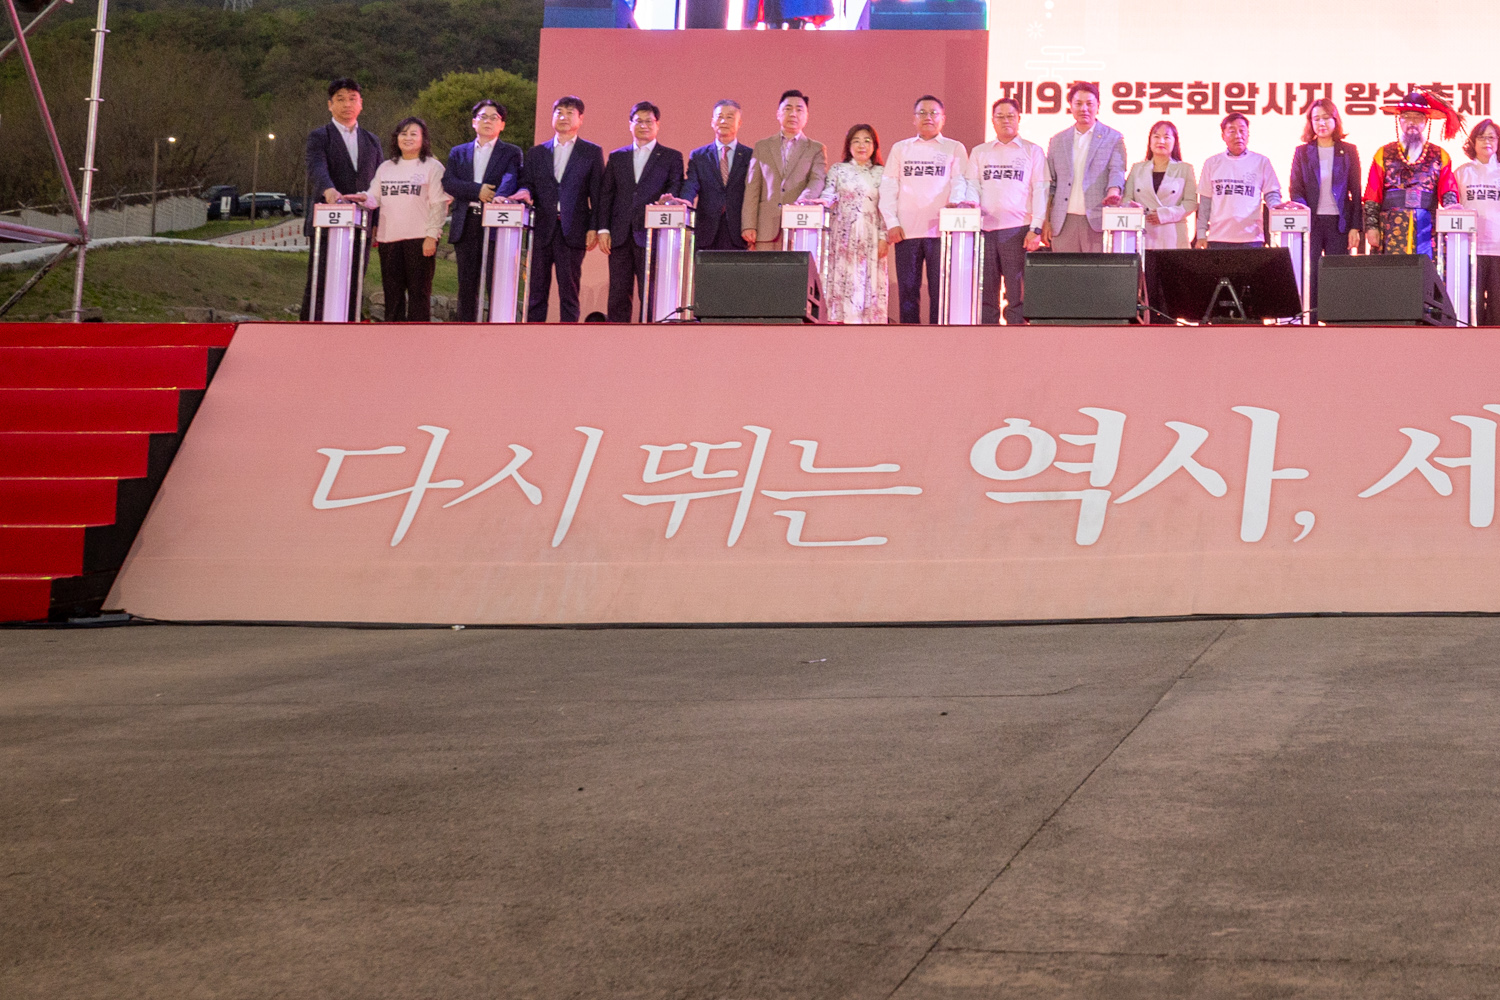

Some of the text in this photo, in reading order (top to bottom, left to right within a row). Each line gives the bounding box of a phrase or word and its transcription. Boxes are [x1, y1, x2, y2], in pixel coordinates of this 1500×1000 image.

[1000, 81, 1100, 115] 제9
[903, 164, 946, 178] 왕실축제
[983, 168, 1025, 183] 왕실축제
[1214, 183, 1255, 198] 왕실축제
[497, 212, 509, 224] 주
[660, 213, 672, 226] 회
[796, 213, 809, 226] 암
[1117, 215, 1129, 228] 지
[1283, 217, 1296, 230] 유
[1450, 217, 1463, 230] 네
[313, 425, 604, 547] 다시
[623, 425, 923, 547] 뛰는
[970, 406, 1314, 543] 역사,
